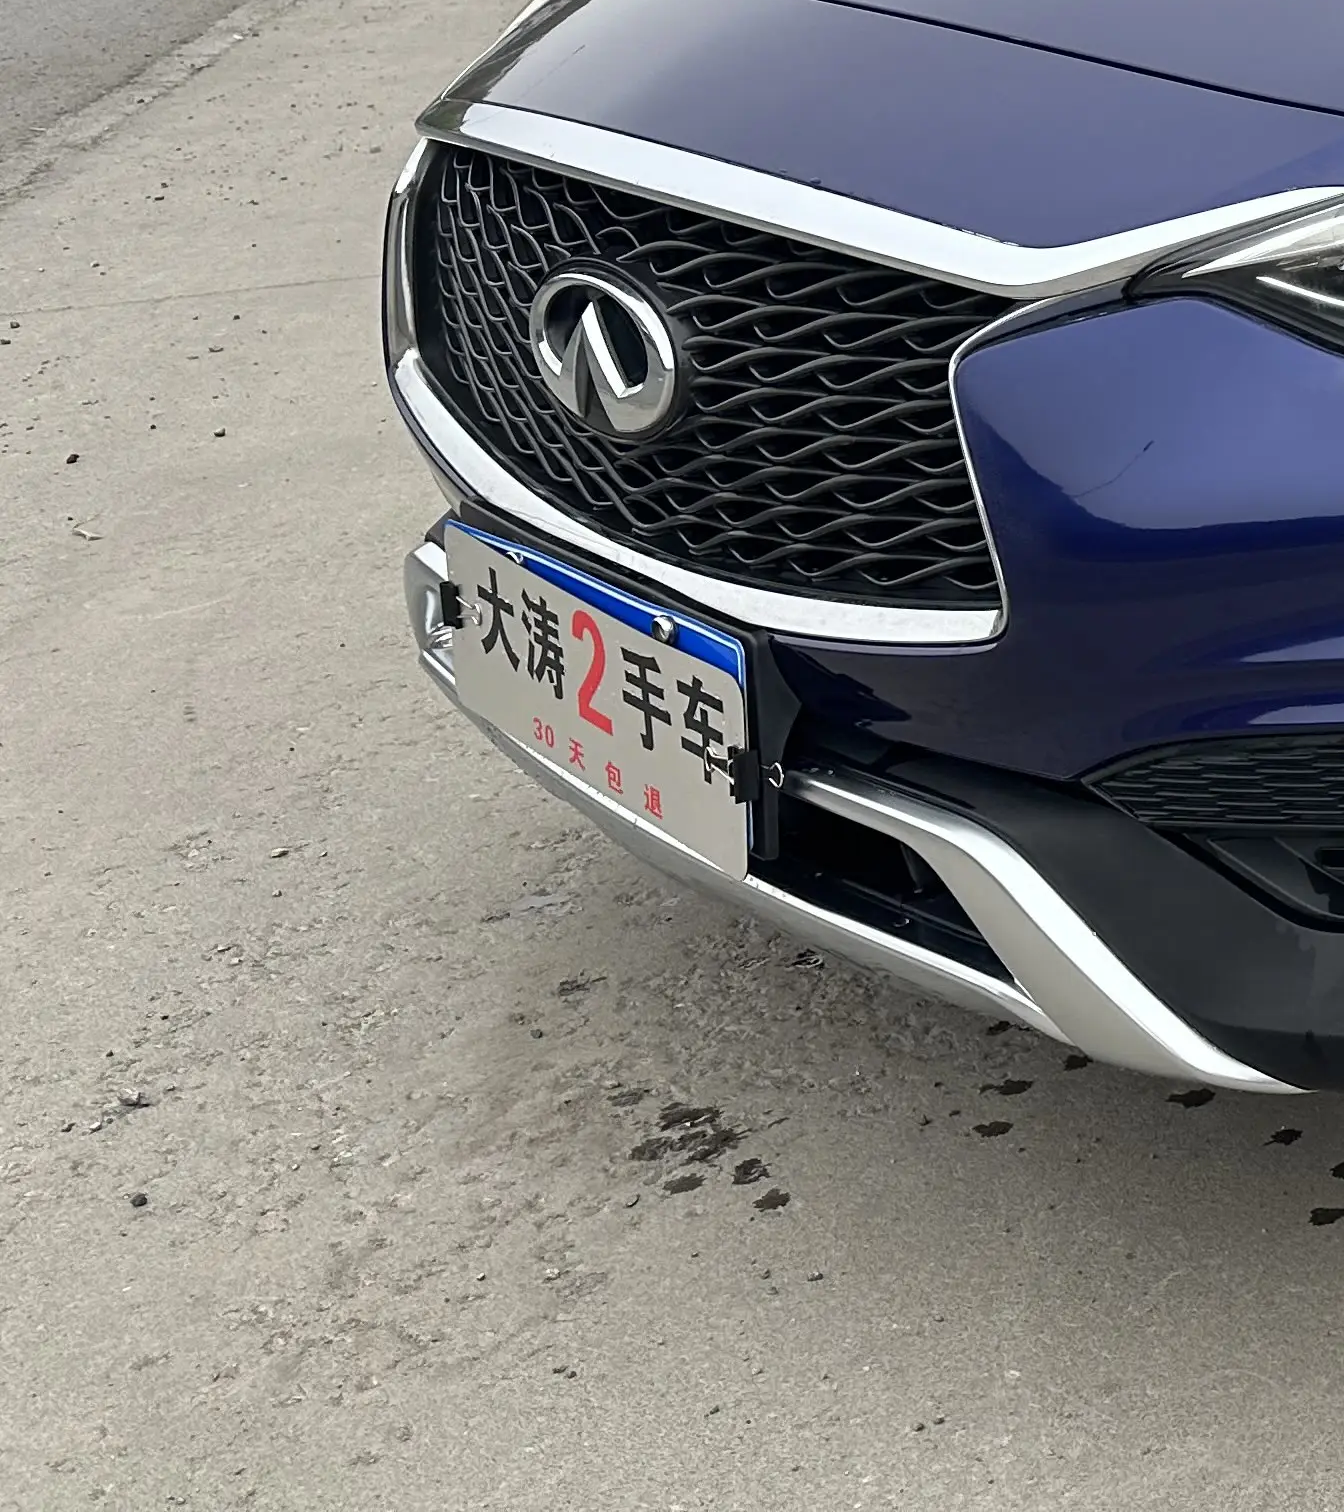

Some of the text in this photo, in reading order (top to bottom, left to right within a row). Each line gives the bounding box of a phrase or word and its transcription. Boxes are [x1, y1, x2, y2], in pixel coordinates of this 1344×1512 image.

[476, 566, 724, 785] 大涛2手车
[532, 717, 664, 820] 30天包退
